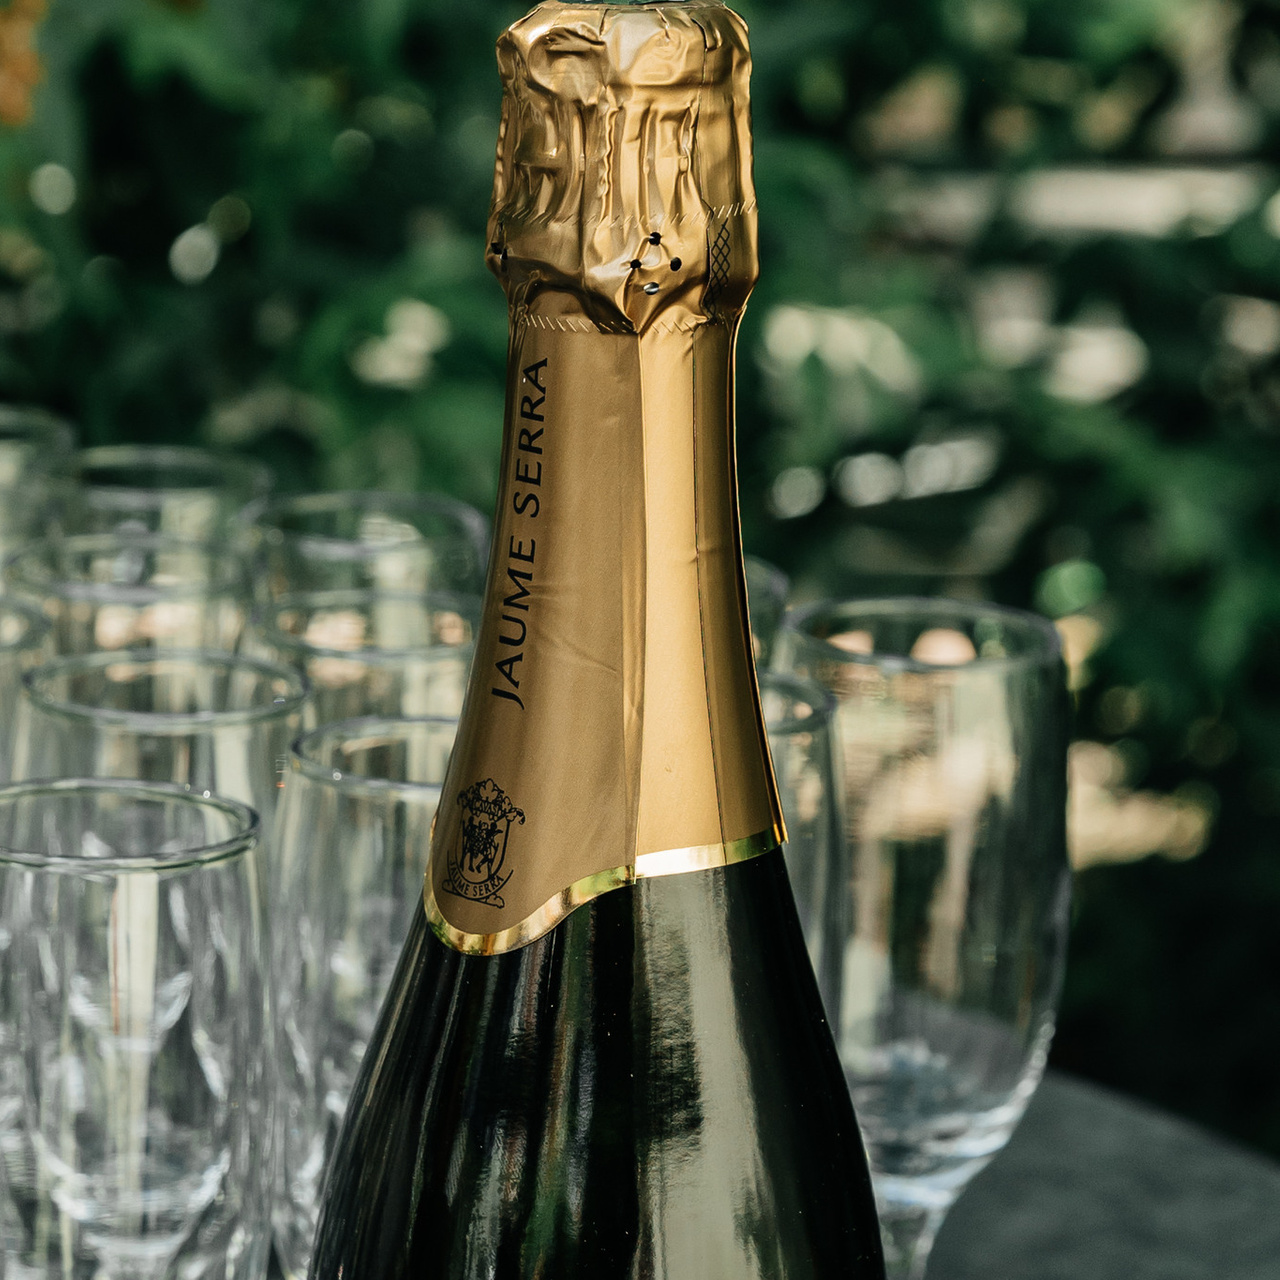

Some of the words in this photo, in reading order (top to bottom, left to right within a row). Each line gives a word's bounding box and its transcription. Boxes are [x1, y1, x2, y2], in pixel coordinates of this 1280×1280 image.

[490, 535, 536, 711] JAUME
[513, 357, 548, 519] SERRA
[449, 861, 471, 896] JAUME
[472, 875, 504, 897] SERRA
